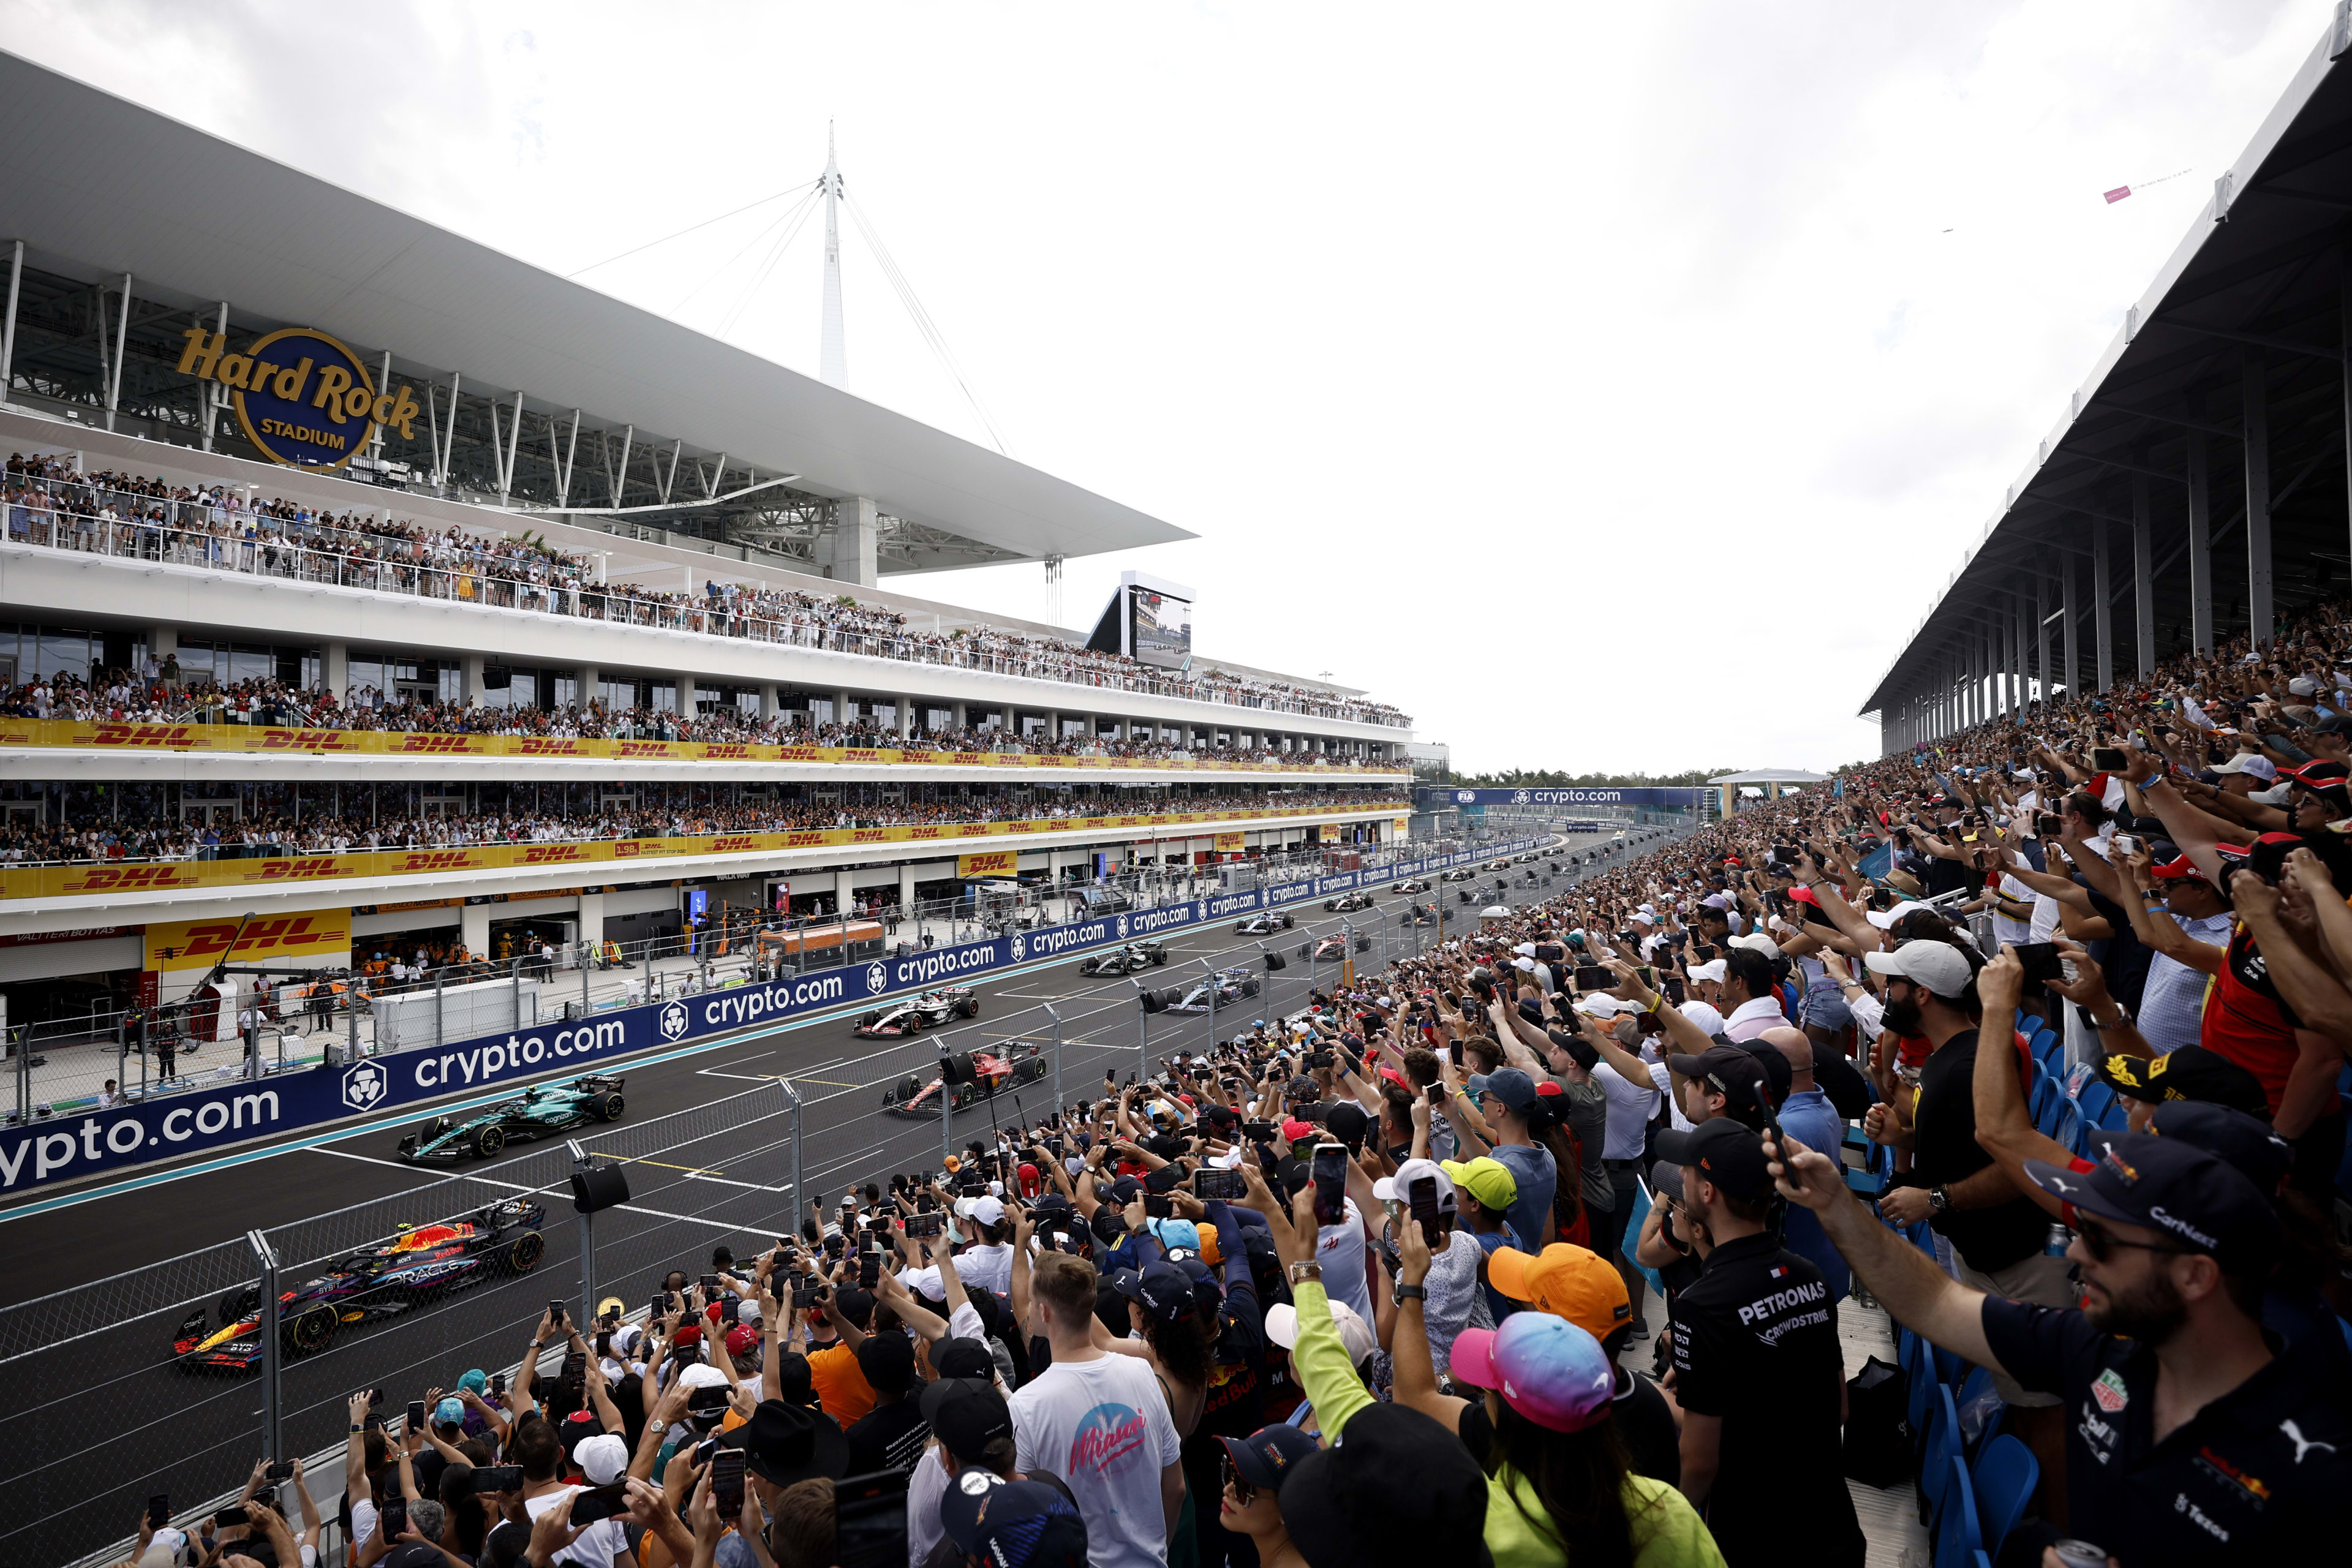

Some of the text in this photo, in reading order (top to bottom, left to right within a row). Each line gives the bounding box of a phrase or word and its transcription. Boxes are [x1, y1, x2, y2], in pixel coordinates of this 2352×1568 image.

[176, 327, 419, 440] Hard Rock
[261, 418, 345, 450] STADIUM
[93, 725, 194, 745] DHL
[262, 731, 344, 748] DHL
[403, 736, 472, 752] DHL
[520, 739, 579, 754] DHL
[619, 743, 670, 756] DHL
[705, 745, 749, 758] DHL
[779, 748, 817, 760] DHL
[845, 750, 878, 761] DHL
[902, 752, 932, 763] DHL
[953, 753, 979, 764] DHL
[999, 755, 1023, 765] DHL
[1039, 757, 1061, 766] DHL
[1077, 758, 1096, 766] DHL
[1458, 791, 1474, 802] FIA
[1535, 790, 1621, 804] crypto.com
[962, 825, 987, 835] DHL
[1008, 823, 1031, 832] DHL
[1050, 821, 1069, 830] DHL
[1087, 819, 1104, 827] DHL
[787, 833, 823, 846] DHL
[853, 830, 886, 842] DHL
[911, 827, 940, 838] DHL
[1221, 833, 1240, 846] DHL
[712, 837, 753, 851] DHL
[405, 852, 471, 870] DHL
[525, 846, 580, 862] DHL
[1454, 852, 1470, 862] crypto.com
[260, 859, 341, 879] DHL
[970, 854, 1009, 873] DHL
[1428, 857, 1447, 868] cryptocom
[82, 867, 181, 889] DHL
[1364, 868, 1389, 882] crypto.com
[1322, 875, 1352, 891] crypto.com
[537, 888, 561, 897] PIASTRI
[1273, 883, 1308, 902] crypto.com
[1211, 893, 1255, 914] crypto.com
[1134, 907, 1189, 931] crypto.com
[17, 926, 116, 941] VALTTERI BOTTAS
[184, 917, 322, 956] DHL
[1033, 923, 1105, 952] crypto.com
[898, 944, 994, 982] crypto.com
[705, 976, 842, 1023] crypto.com
[415, 1020, 625, 1087] crypto.com
[541, 1090, 567, 1099] aramco
[545, 1111, 573, 1125] cognizant
[1430, 1117, 1449, 1131] TRO
[2149, 1205, 2220, 1251] CarNext
[469, 1234, 489, 1244] HONDA
[396, 1256, 412, 1264] ROKT
[385, 1261, 458, 1285] ORACLE
[318, 1282, 341, 1294] BYBIT
[1140, 1287, 1159, 1308] CarNext
[1738, 1281, 1826, 1326] PETRONAS
[184, 1317, 202, 1329] Claro
[1765, 1308, 1830, 1341] CROWDSTRIKE
[1227, 1370, 1258, 1402] Bull
[1069, 1408, 1146, 1476] Miami
